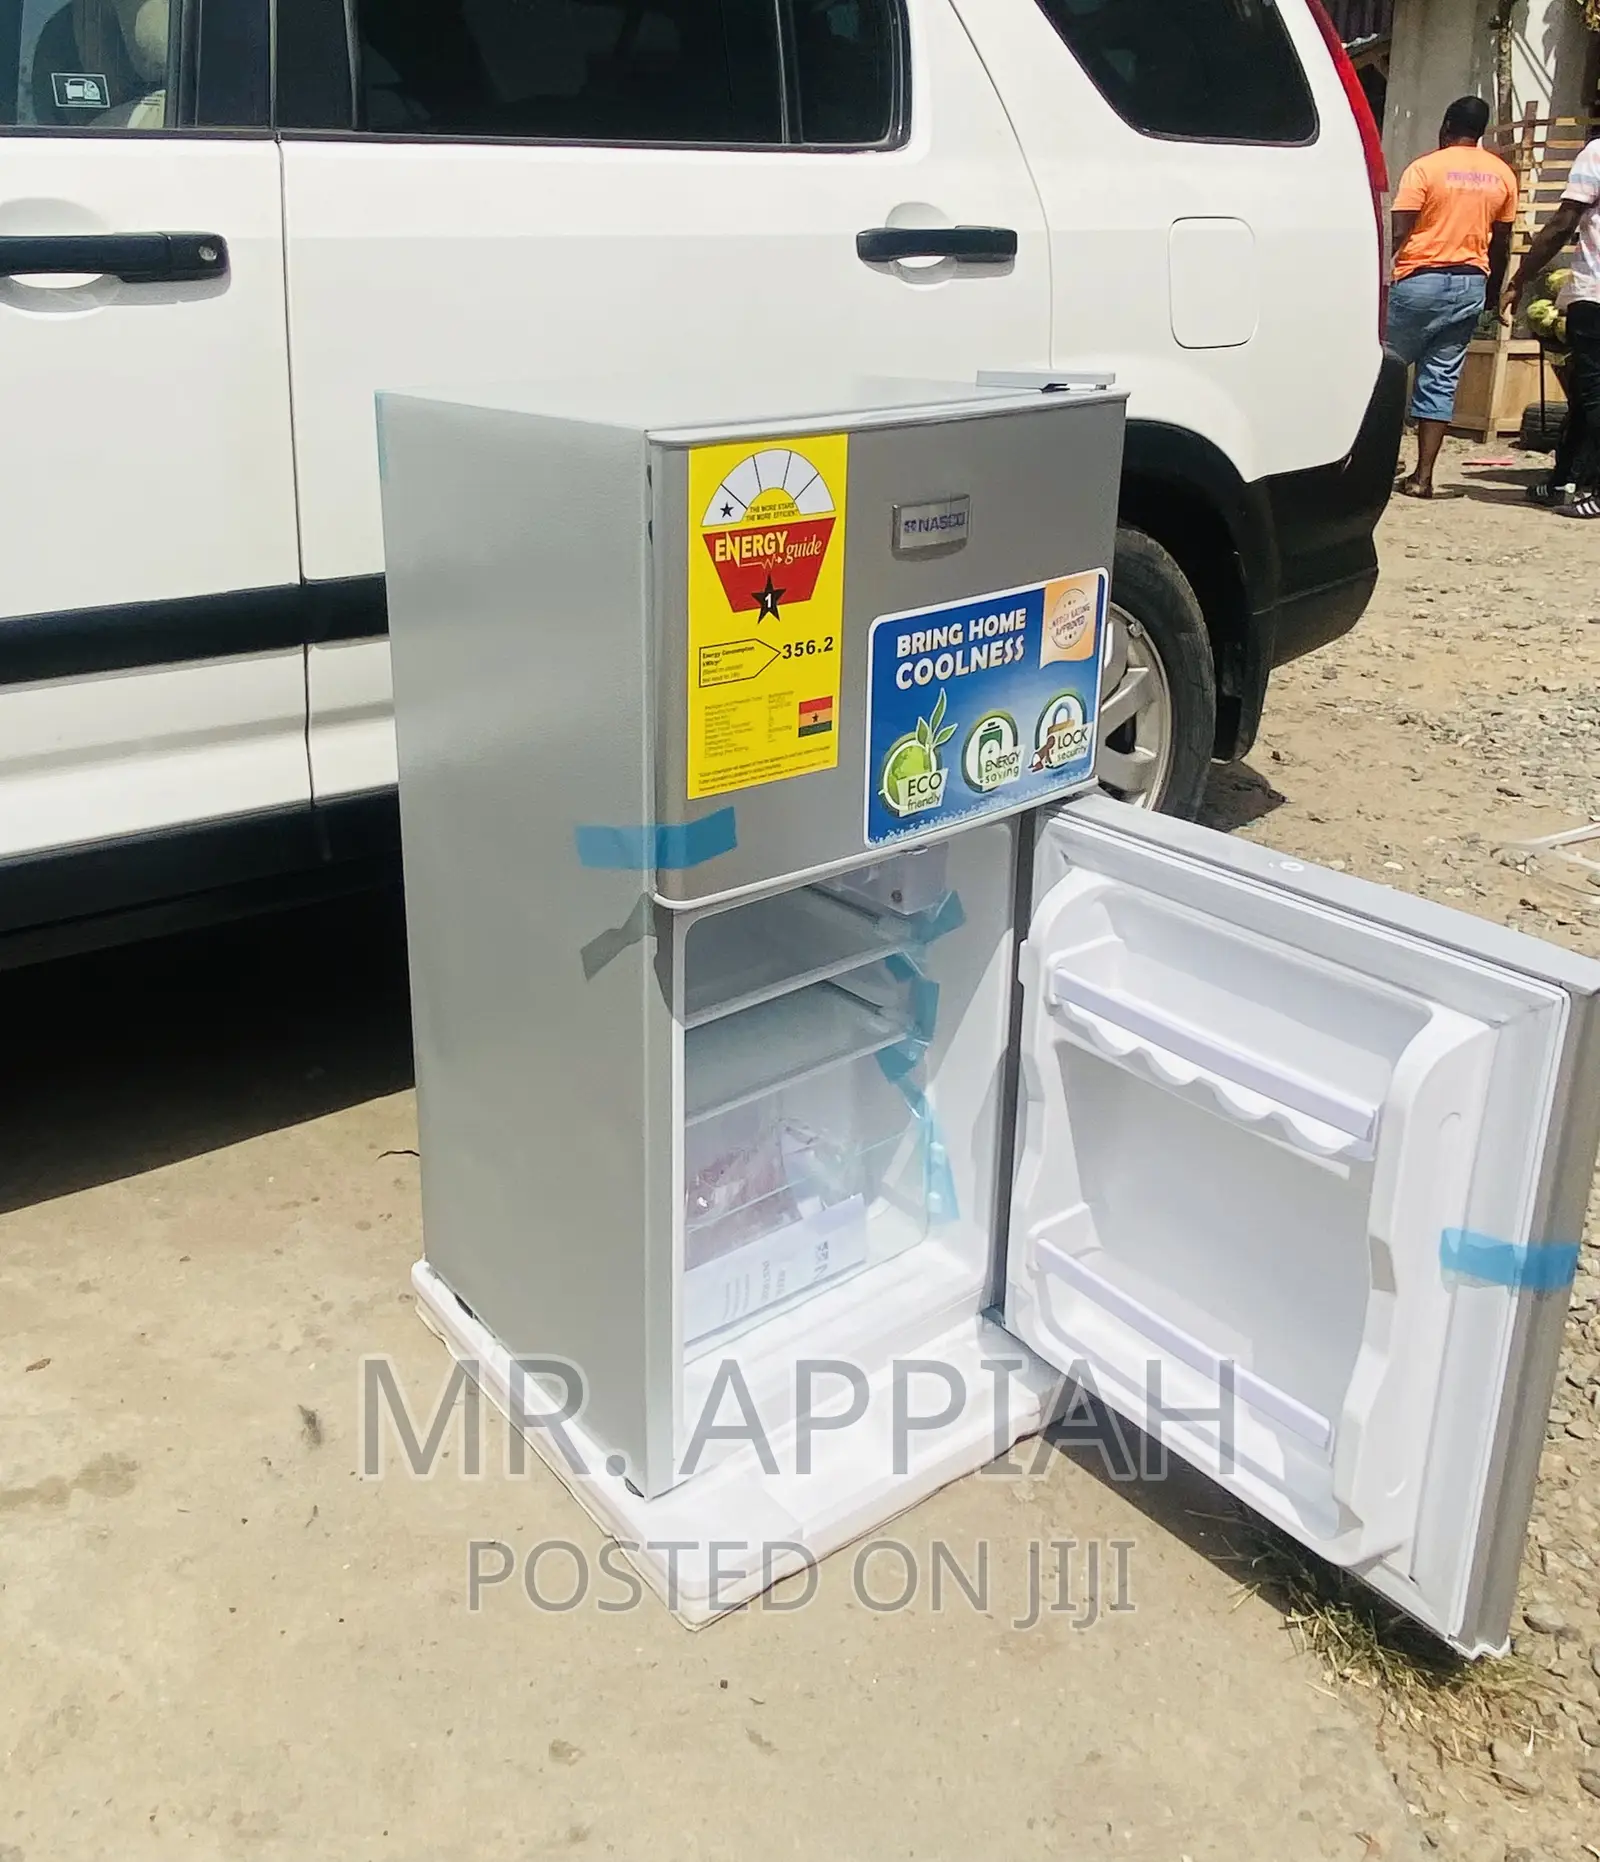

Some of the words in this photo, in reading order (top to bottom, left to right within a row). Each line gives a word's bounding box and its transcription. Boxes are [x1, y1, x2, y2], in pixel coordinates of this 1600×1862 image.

[715, 530, 788, 568] ENERGY
[784, 533, 822, 565] guide
[764, 592, 772, 608] 1
[896, 624, 964, 658] BRING
[968, 607, 1027, 640] HOME
[782, 636, 833, 659] 356.2
[895, 635, 1026, 691] COOLNESS
[1057, 729, 1088, 749] LOCK
[985, 750, 1021, 773] ENERGY
[1056, 745, 1087, 762] security
[907, 772, 942, 797] ECO
[985, 766, 1019, 784] saving
[907, 792, 940, 811] friendly
